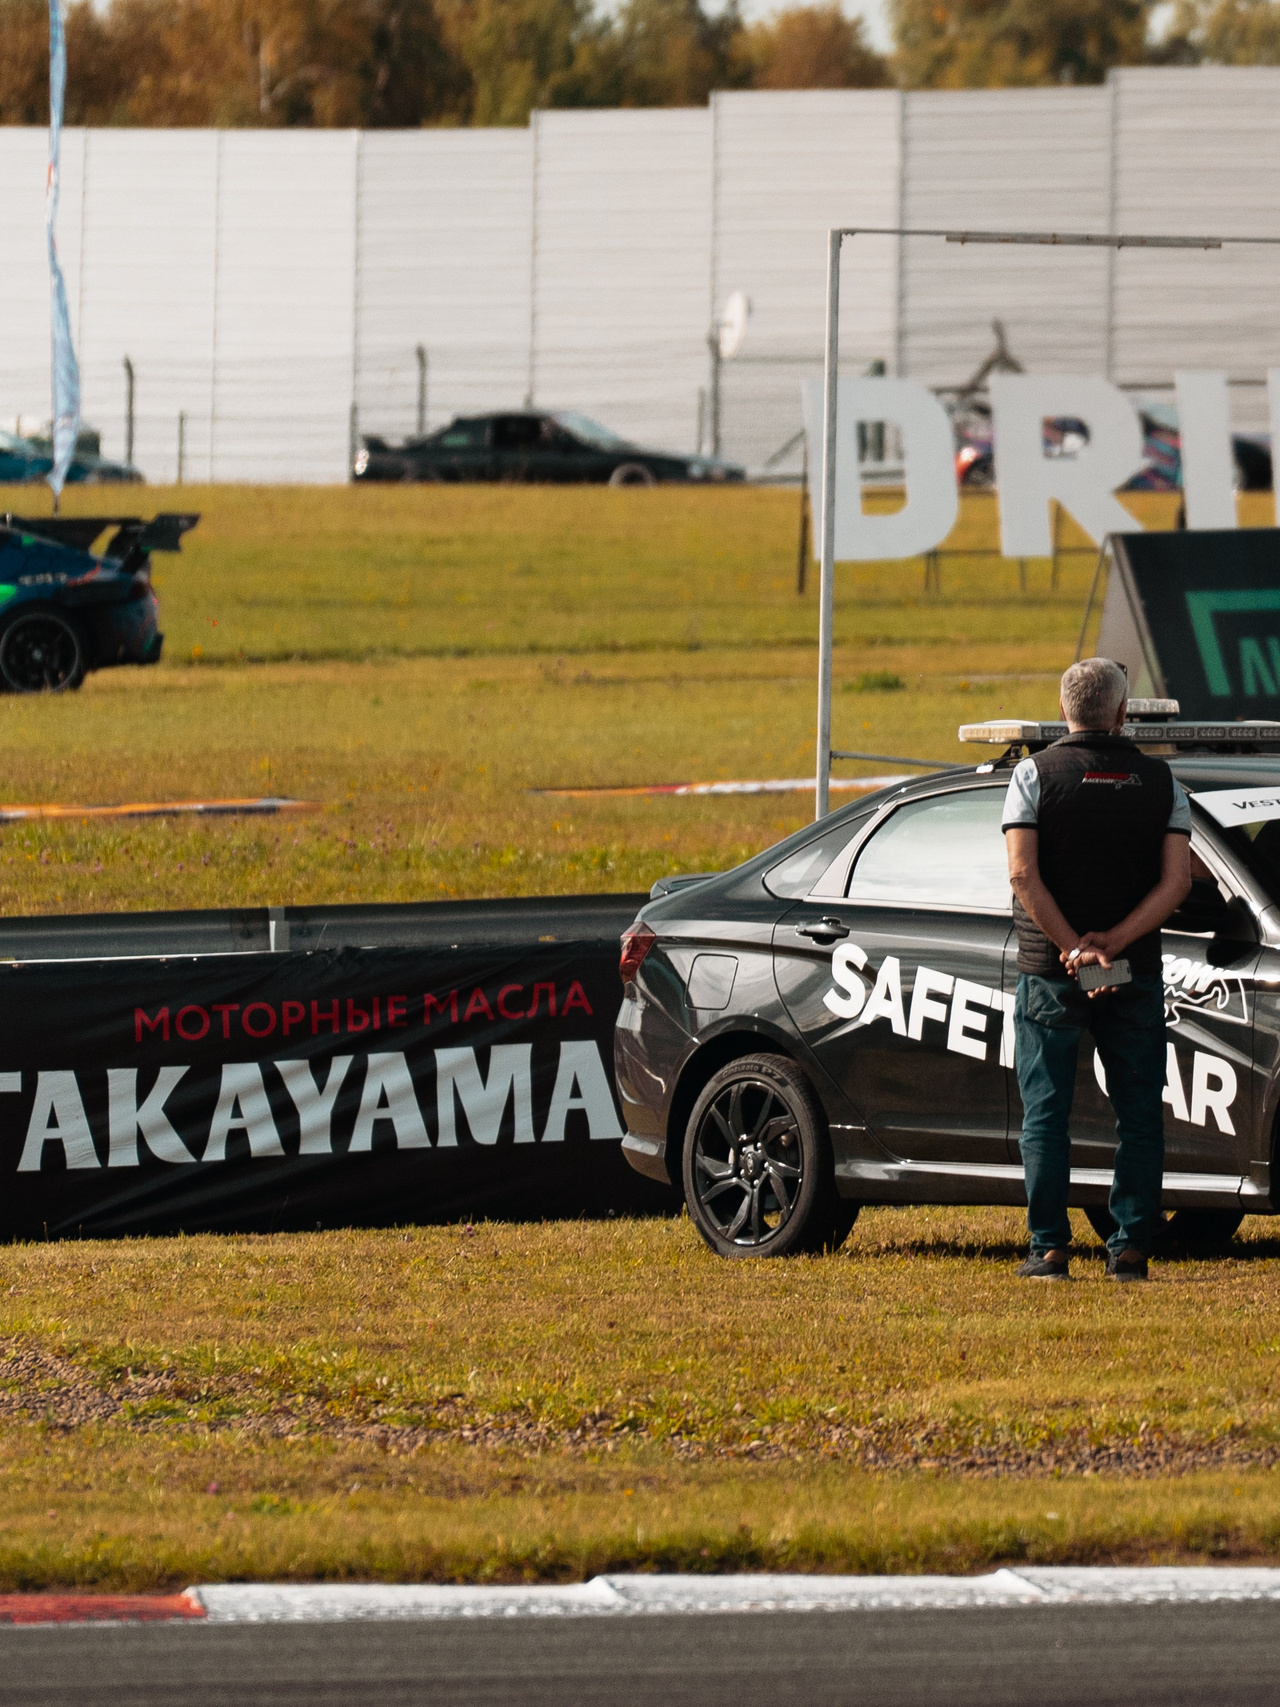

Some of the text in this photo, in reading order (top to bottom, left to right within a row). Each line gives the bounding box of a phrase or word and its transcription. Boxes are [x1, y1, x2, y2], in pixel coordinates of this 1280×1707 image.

[134, 980, 593, 1042] МОТОРНЫЕ МАСЛА
[822, 943, 1237, 1137] SAFET AR
